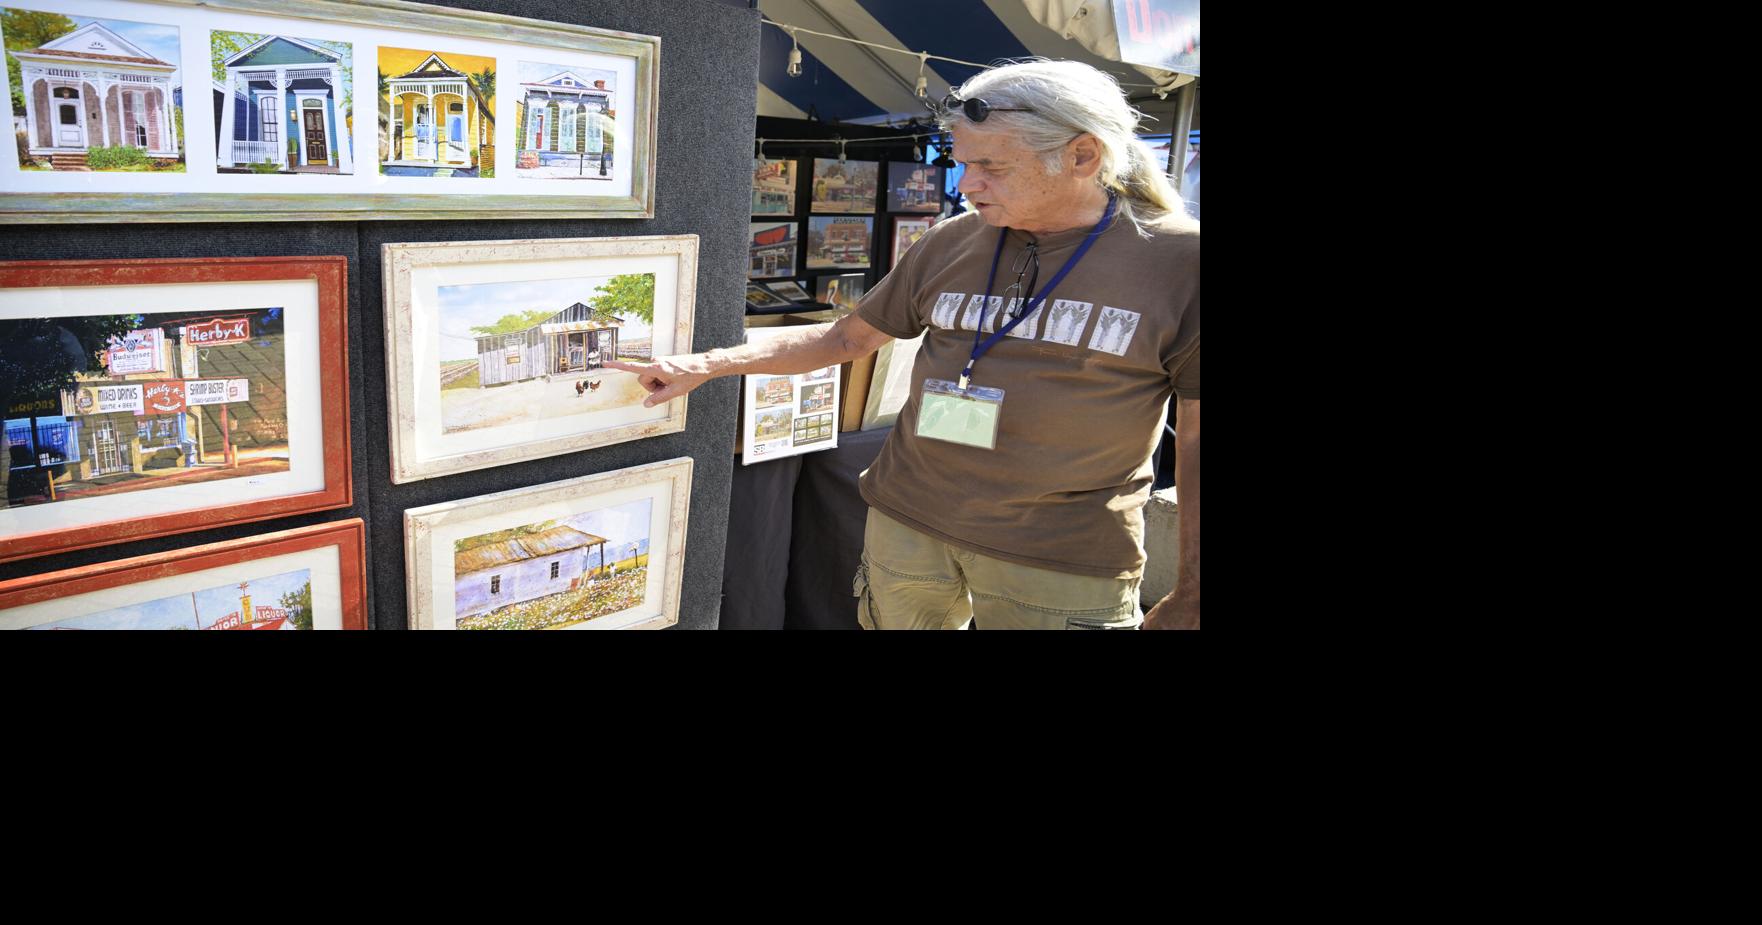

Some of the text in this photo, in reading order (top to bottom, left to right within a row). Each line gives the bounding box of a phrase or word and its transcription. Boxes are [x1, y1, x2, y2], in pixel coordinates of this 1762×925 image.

[190, 323, 245, 341] Herby-K
[113, 352, 151, 360] Budweiser
[98, 387, 138, 402] MIXED DRINKS
